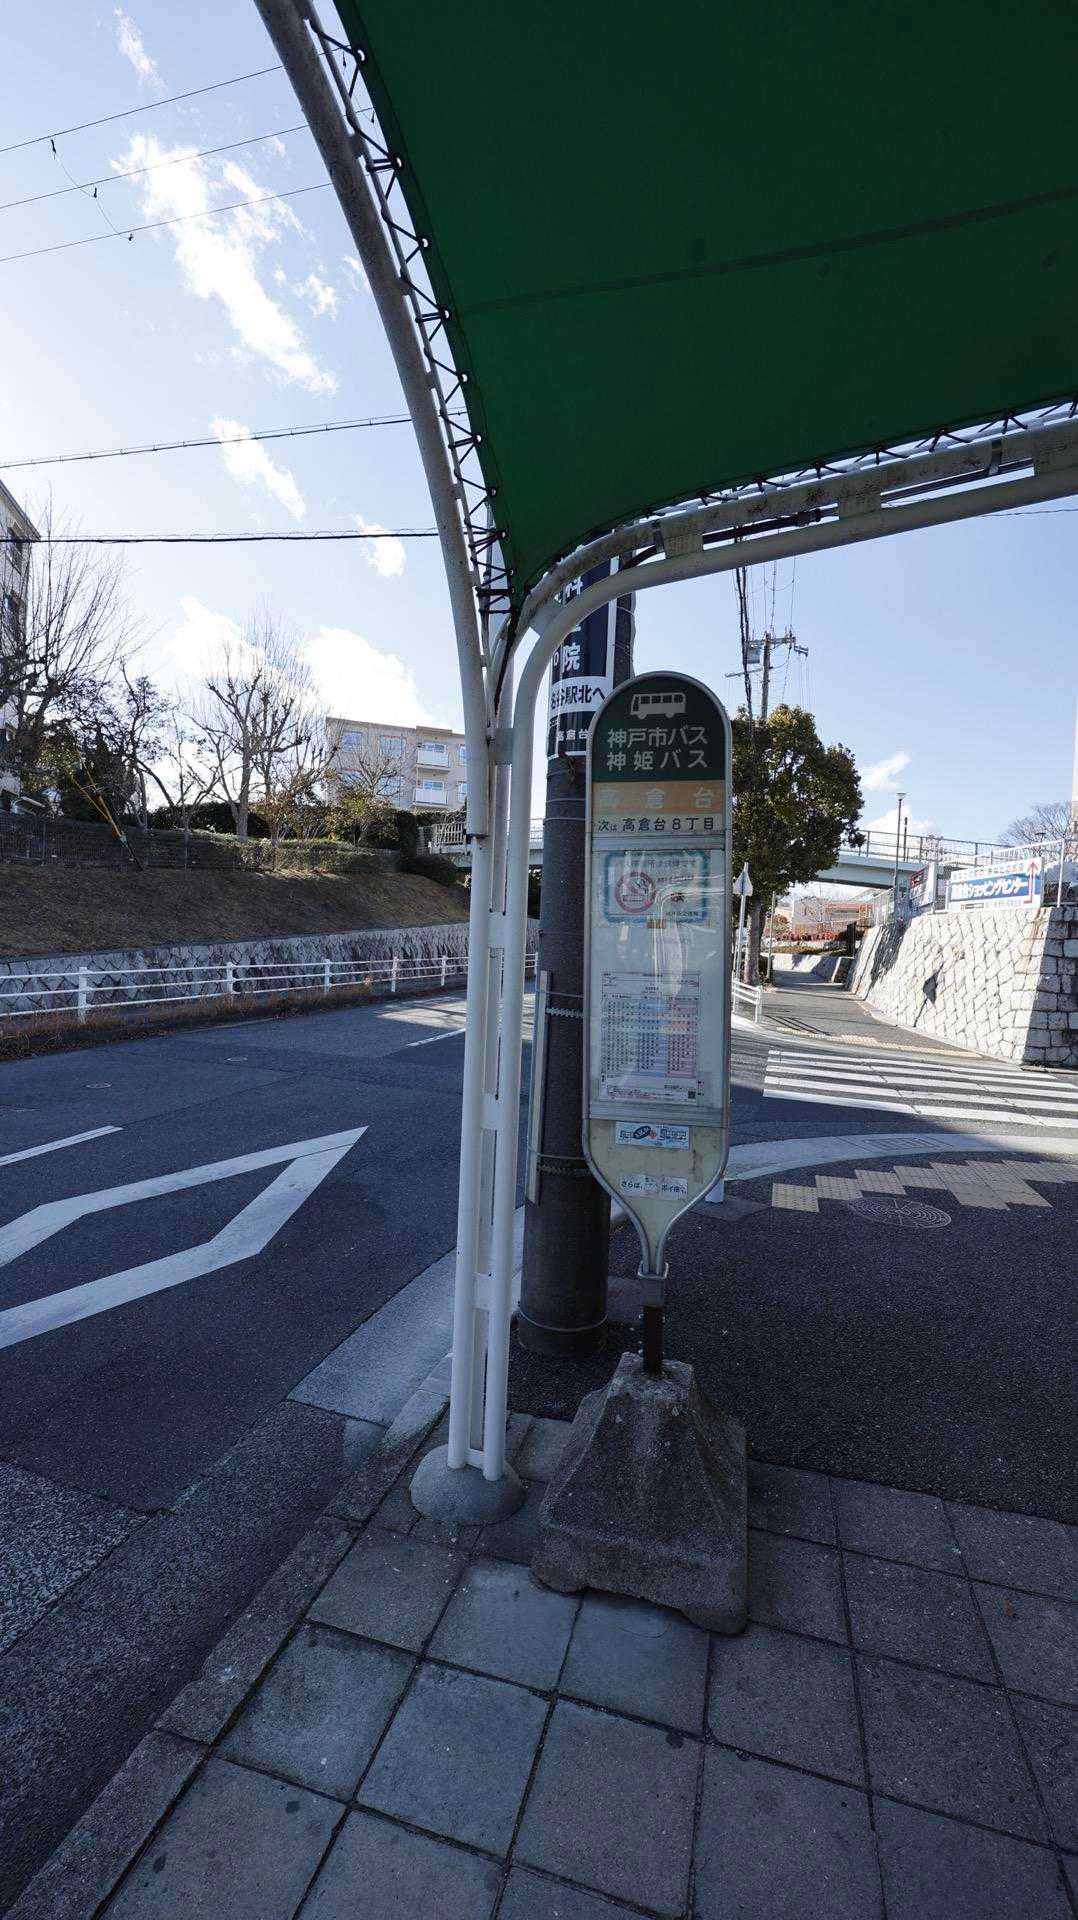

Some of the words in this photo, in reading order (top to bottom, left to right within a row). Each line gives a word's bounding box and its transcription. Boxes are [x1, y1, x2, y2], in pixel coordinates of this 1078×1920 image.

[607, 727, 709, 749] 神戸市バス
[606, 750, 709, 772] 神姫バス
